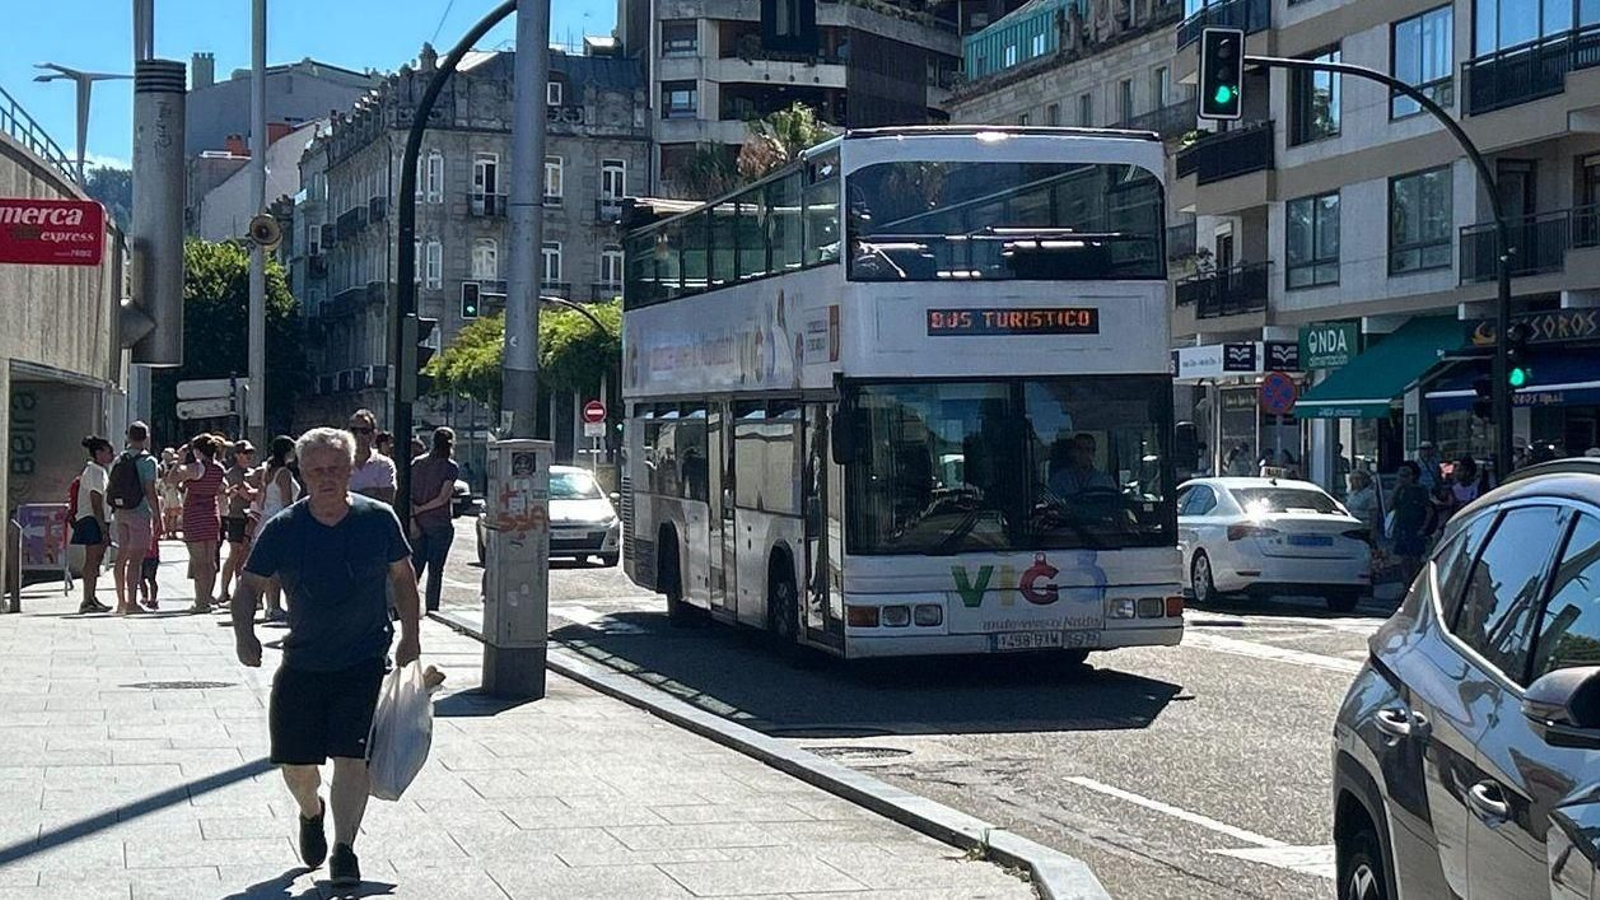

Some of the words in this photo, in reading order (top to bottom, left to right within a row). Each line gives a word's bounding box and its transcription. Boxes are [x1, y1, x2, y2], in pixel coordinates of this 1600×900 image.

[0, 207, 83, 225] merca
[41, 231, 94, 243] express
[931, 311, 971, 328] BUS
[982, 310, 1090, 328] TURISTICO
[1308, 329, 1348, 354] ONDA
